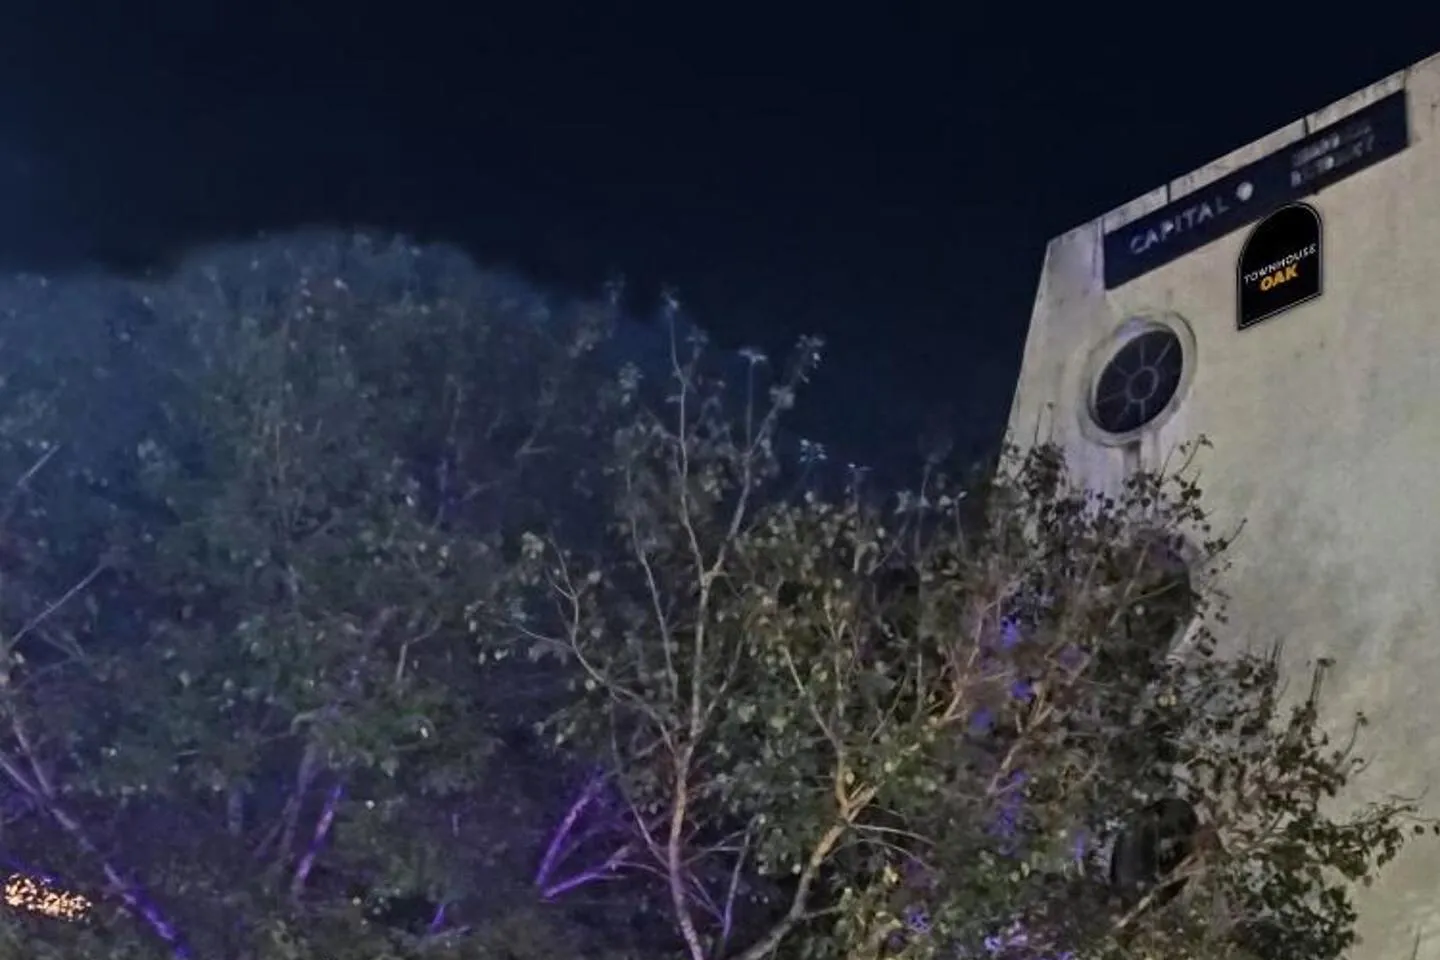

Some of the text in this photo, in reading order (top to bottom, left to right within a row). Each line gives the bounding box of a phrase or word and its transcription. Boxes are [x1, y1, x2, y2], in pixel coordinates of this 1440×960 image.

[1130, 196, 1231, 255] CAPITAL
[1243, 242, 1317, 285] TOWNHOUSE
[1259, 262, 1299, 292] OAK
